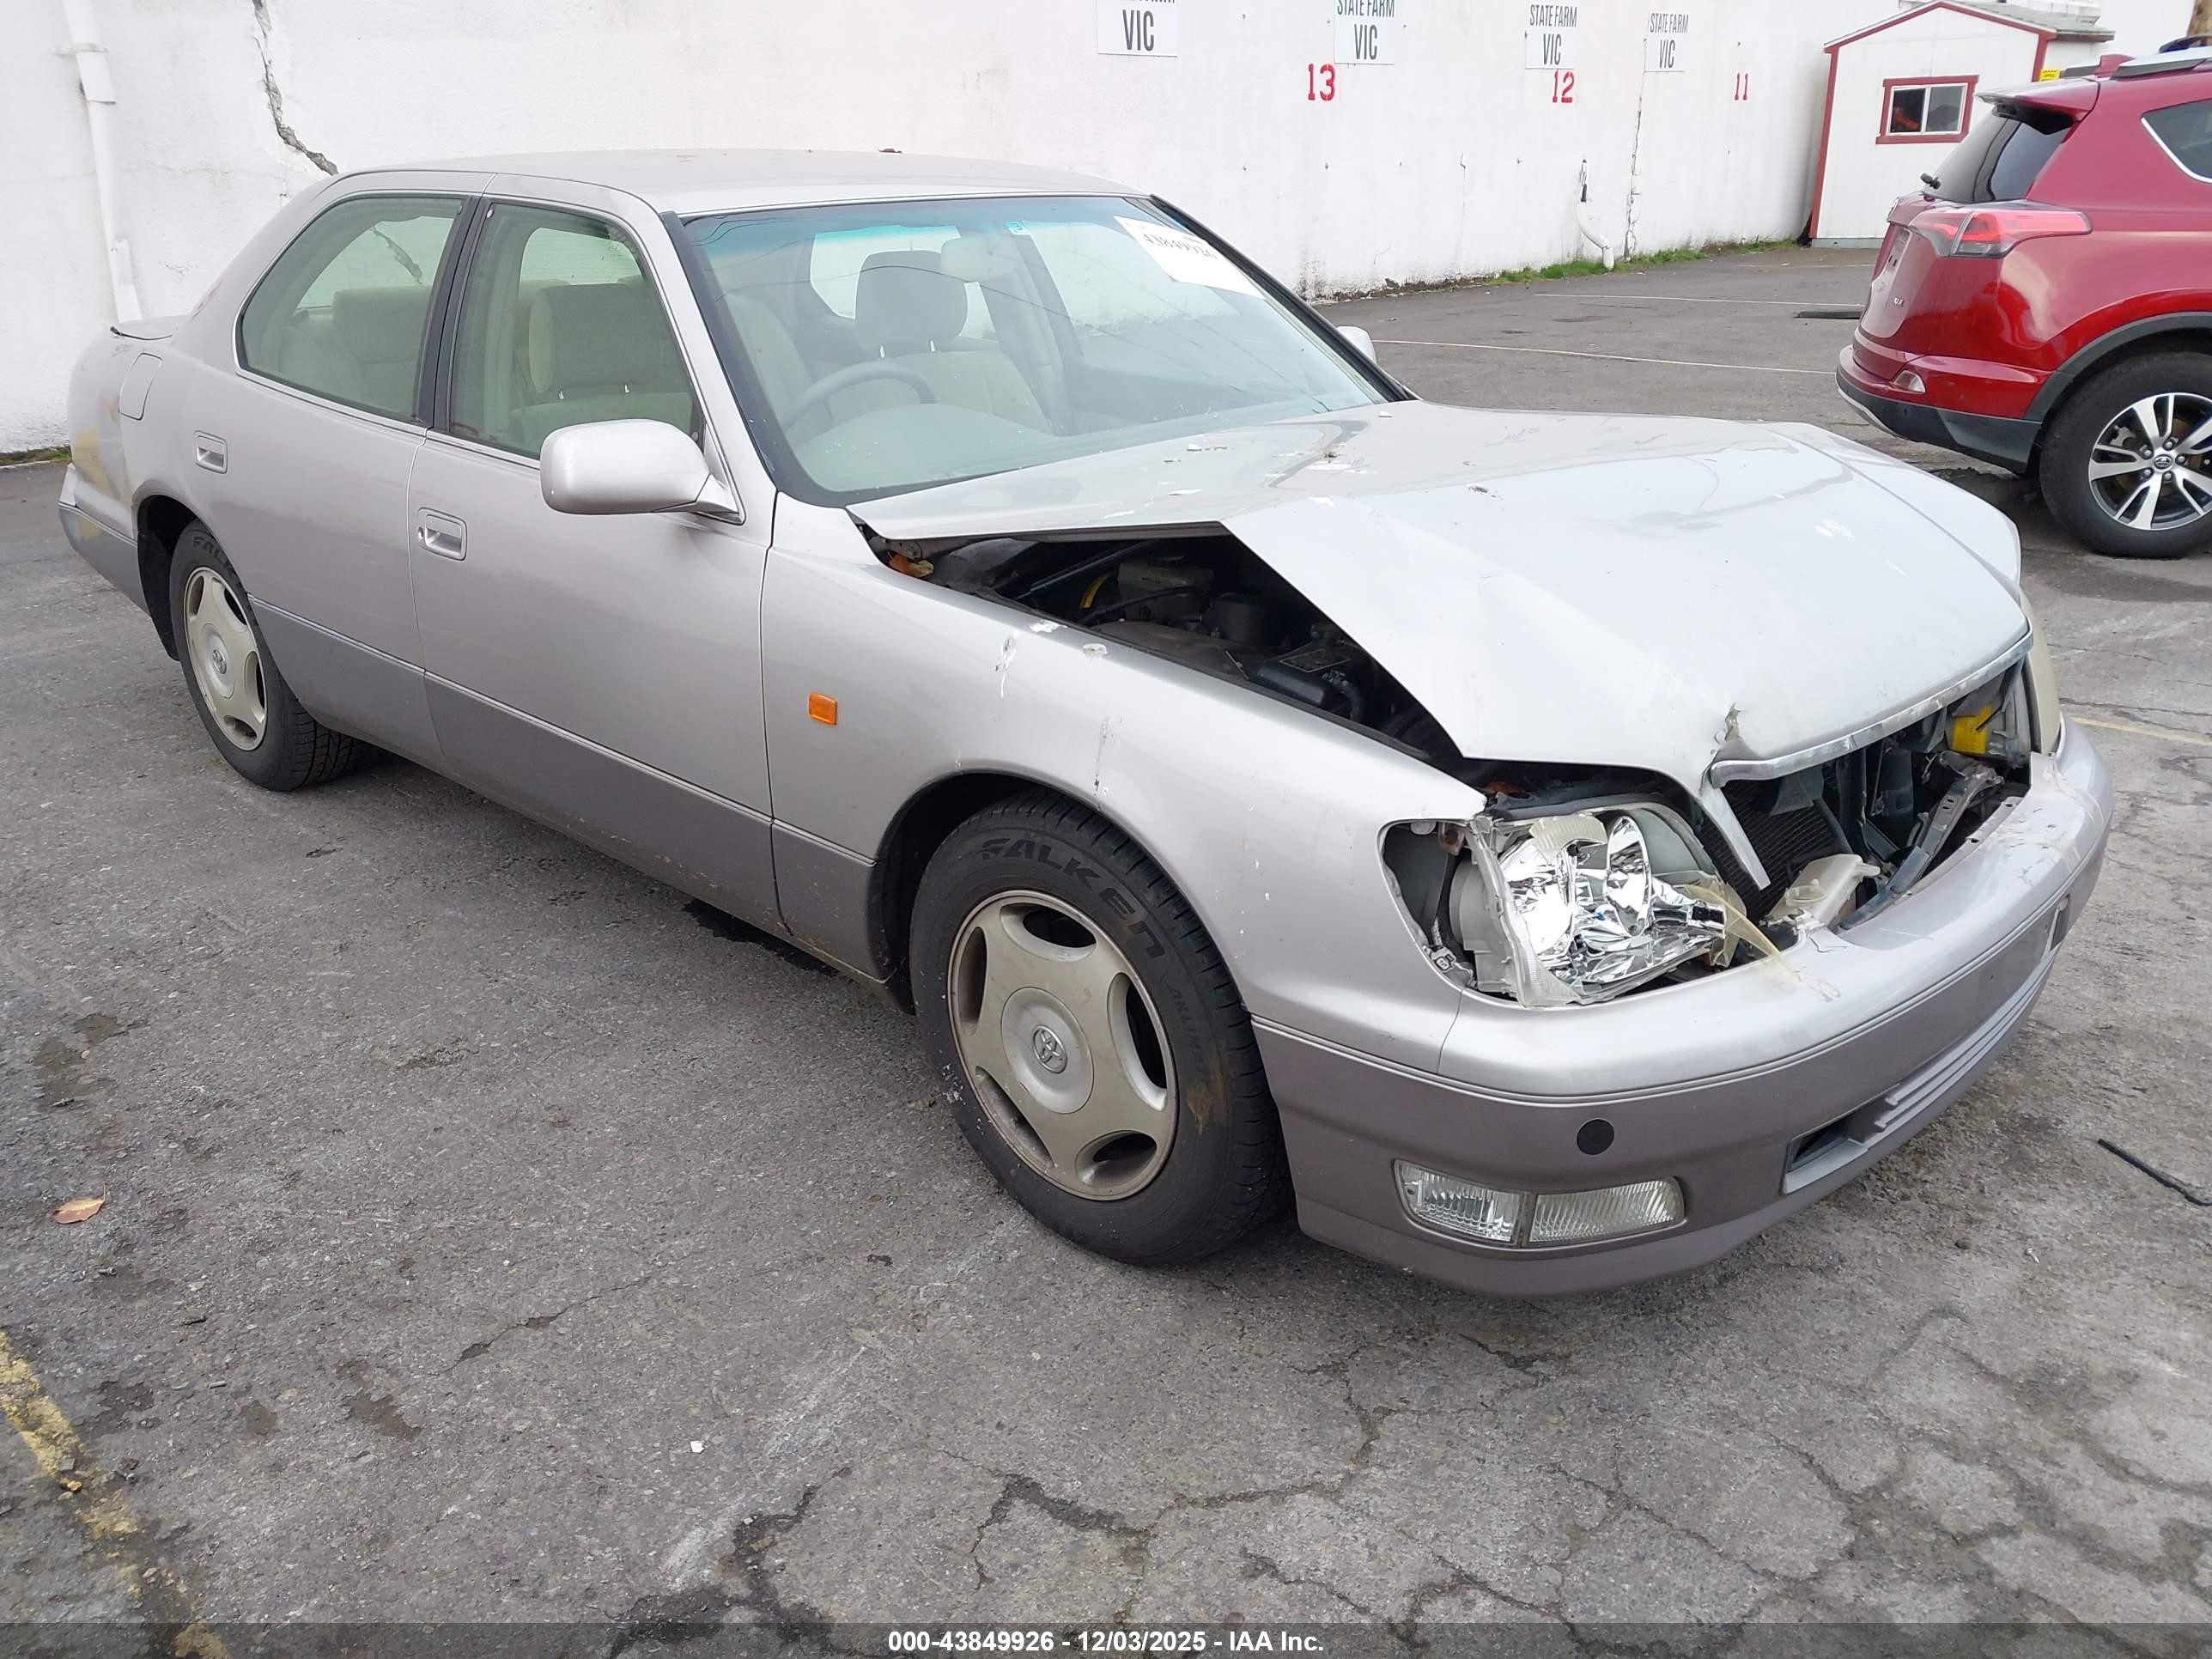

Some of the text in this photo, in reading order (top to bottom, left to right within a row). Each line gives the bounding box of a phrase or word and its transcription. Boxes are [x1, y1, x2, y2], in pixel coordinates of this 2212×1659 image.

[1121, 9, 1155, 52] VIC
[1529, 3, 1577, 28] STATE FARM
[1650, 12, 1689, 33] STATE FARM
[1353, 23, 1378, 60] VIC
[1542, 33, 1562, 65] VIC
[1659, 39, 1676, 69] VIC
[1308, 64, 1336, 101] 13
[1552, 70, 1575, 103] 12
[1734, 72, 1749, 100] 11
